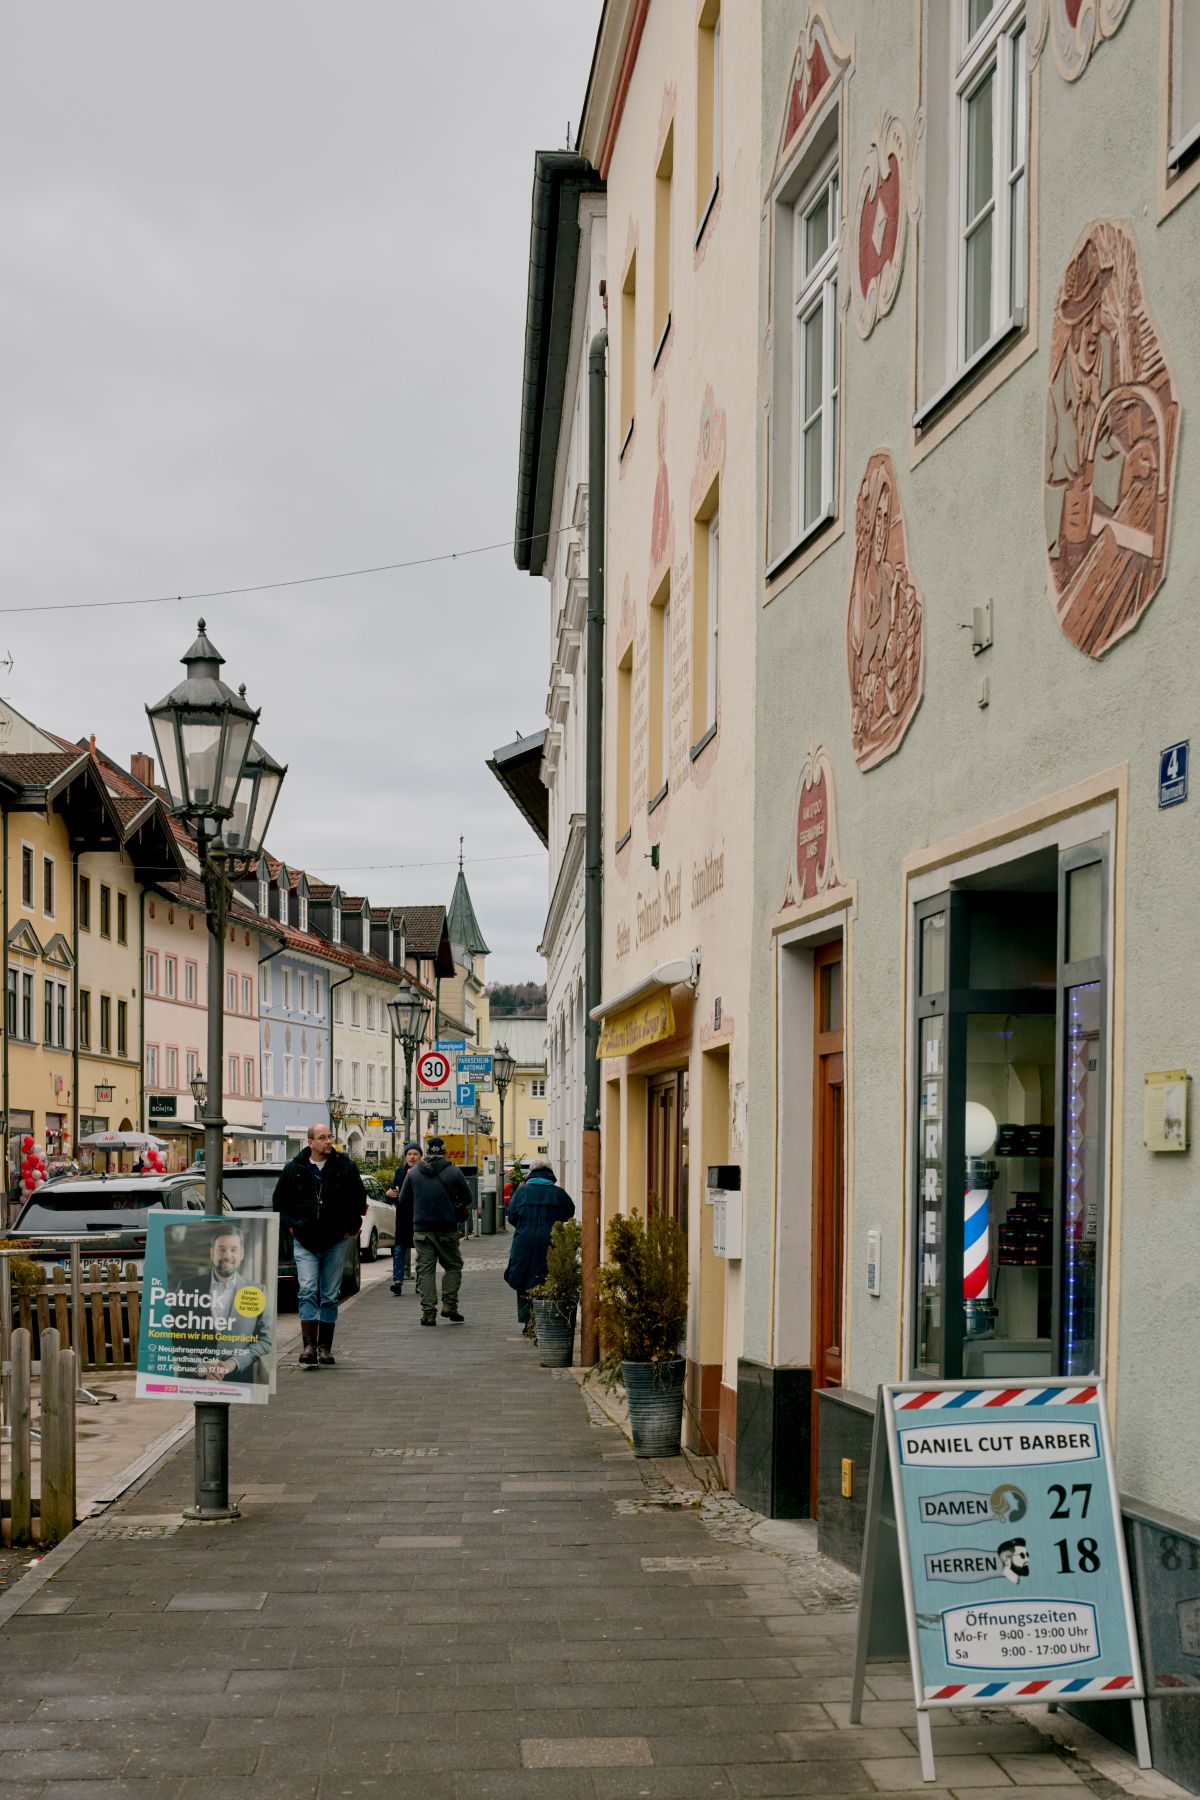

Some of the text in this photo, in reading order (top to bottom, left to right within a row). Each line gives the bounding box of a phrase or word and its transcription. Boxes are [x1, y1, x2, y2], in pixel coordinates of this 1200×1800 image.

[1167, 749, 1179, 779] 4
[424, 1061, 443, 1078] 30
[460, 1086, 471, 1103] P
[923, 1039, 940, 1288] HERREN
[151, 1277, 162, 1286] Dr.
[150, 1286, 225, 1308] Patrick
[148, 1308, 237, 1331] Lechner
[148, 1329, 259, 1343] Kommen wir ins Gespräch!
[158, 1345, 221, 1356] Neujahrsempfang
[167, 1355, 202, 1363] Landhaus
[168, 1364, 198, 1373] Februar,
[216, 1366, 230, 1374] Uhr
[906, 1433, 1091, 1455] DANIEL CUT BARBER
[924, 1483, 1093, 1520] DAMEN 27
[930, 1537, 1100, 1575] HERREN 18
[965, 1610, 1077, 1629] Öffnungszeiten
[954, 1630, 988, 1644] Mo-Fr
[999, 1628, 1024, 1641] 9:00
[1034, 1626, 1065, 1639] 19:00
[1068, 1625, 1089, 1638] Uhr
[955, 1648, 969, 1660] Sa
[1001, 1646, 1026, 1657] 9:00
[1036, 1643, 1067, 1656] 17:00
[1070, 1642, 1091, 1654] Uhr
